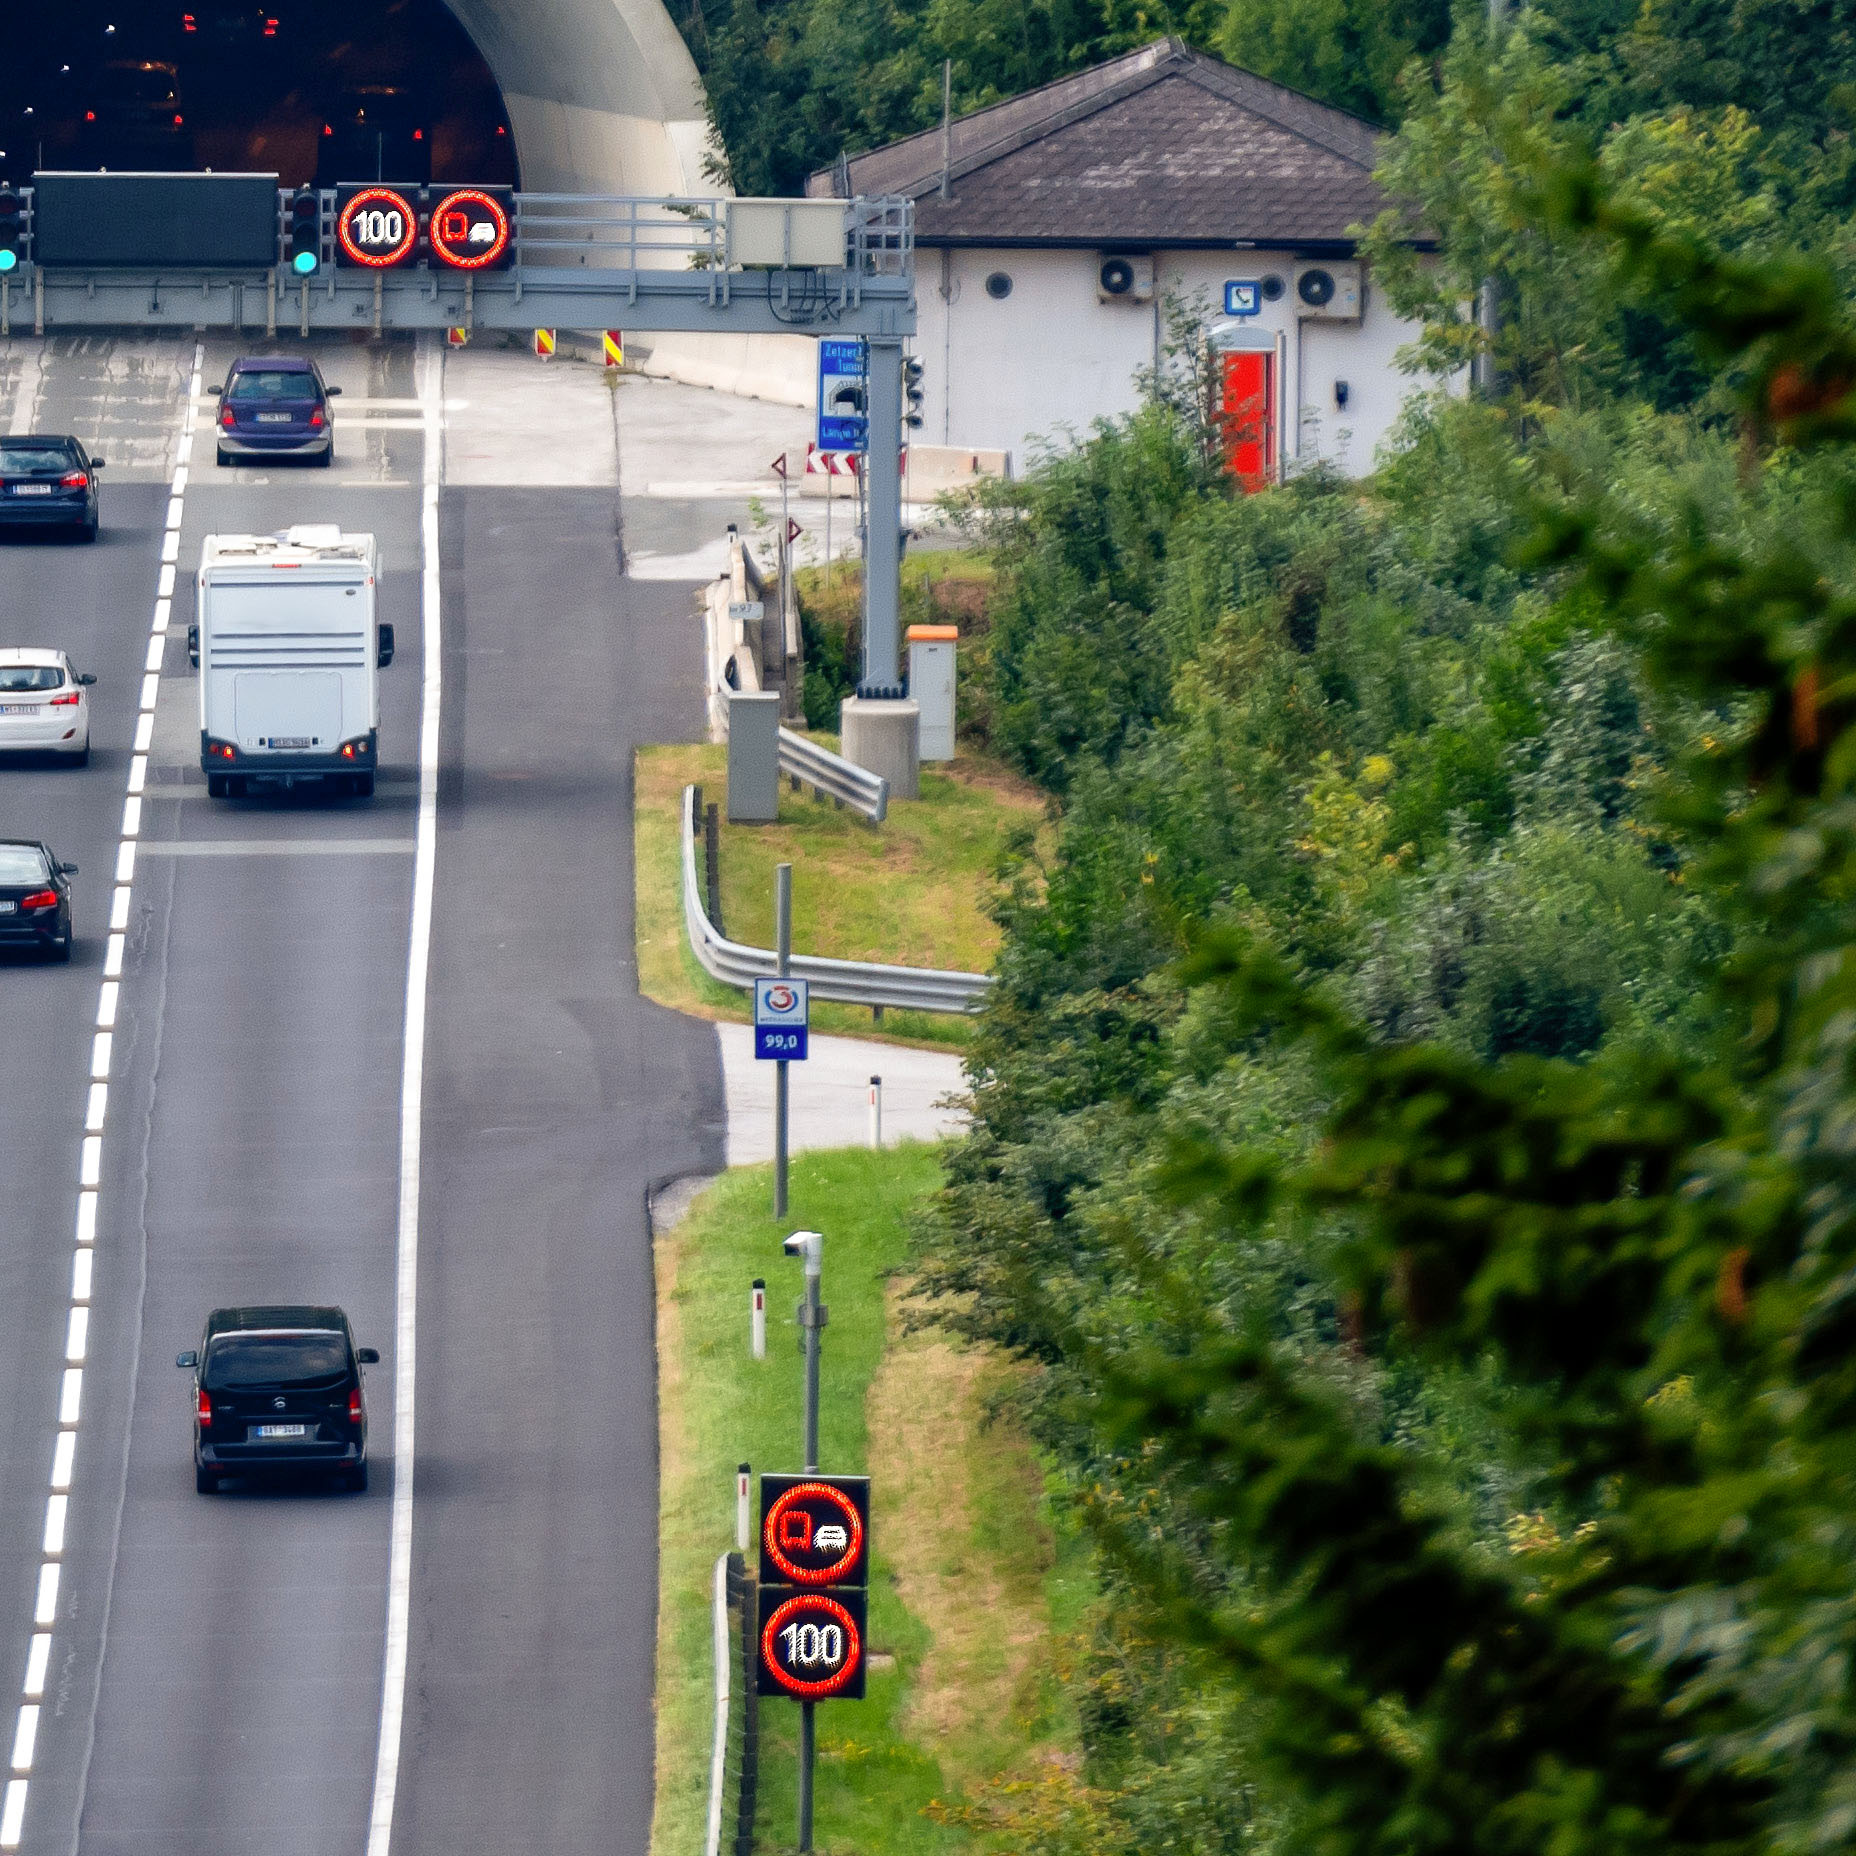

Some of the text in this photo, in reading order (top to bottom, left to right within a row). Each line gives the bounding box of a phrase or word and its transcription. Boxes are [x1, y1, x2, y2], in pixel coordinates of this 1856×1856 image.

[352, 209, 402, 244] 100
[765, 1034, 798, 1050] 99,0
[779, 1622, 841, 1666] 100
